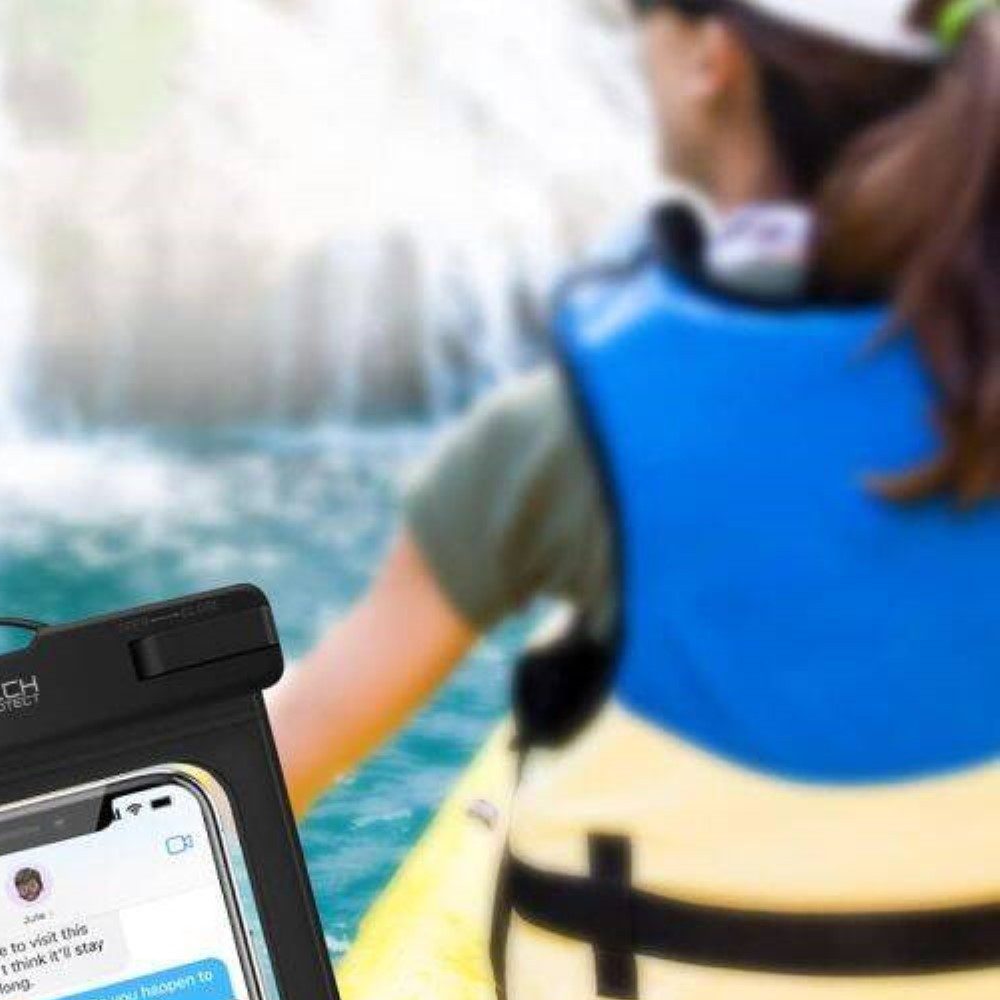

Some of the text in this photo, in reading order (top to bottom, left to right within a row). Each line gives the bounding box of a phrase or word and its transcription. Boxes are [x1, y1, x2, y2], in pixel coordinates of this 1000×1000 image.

[11, 942, 26, 953] to
[30, 931, 58, 948] visit
[61, 923, 88, 940] this
[11, 956, 47, 973] think
[75, 940, 104, 957] stay
[0, 978, 35, 996] long.
[199, 970, 213, 981] to
